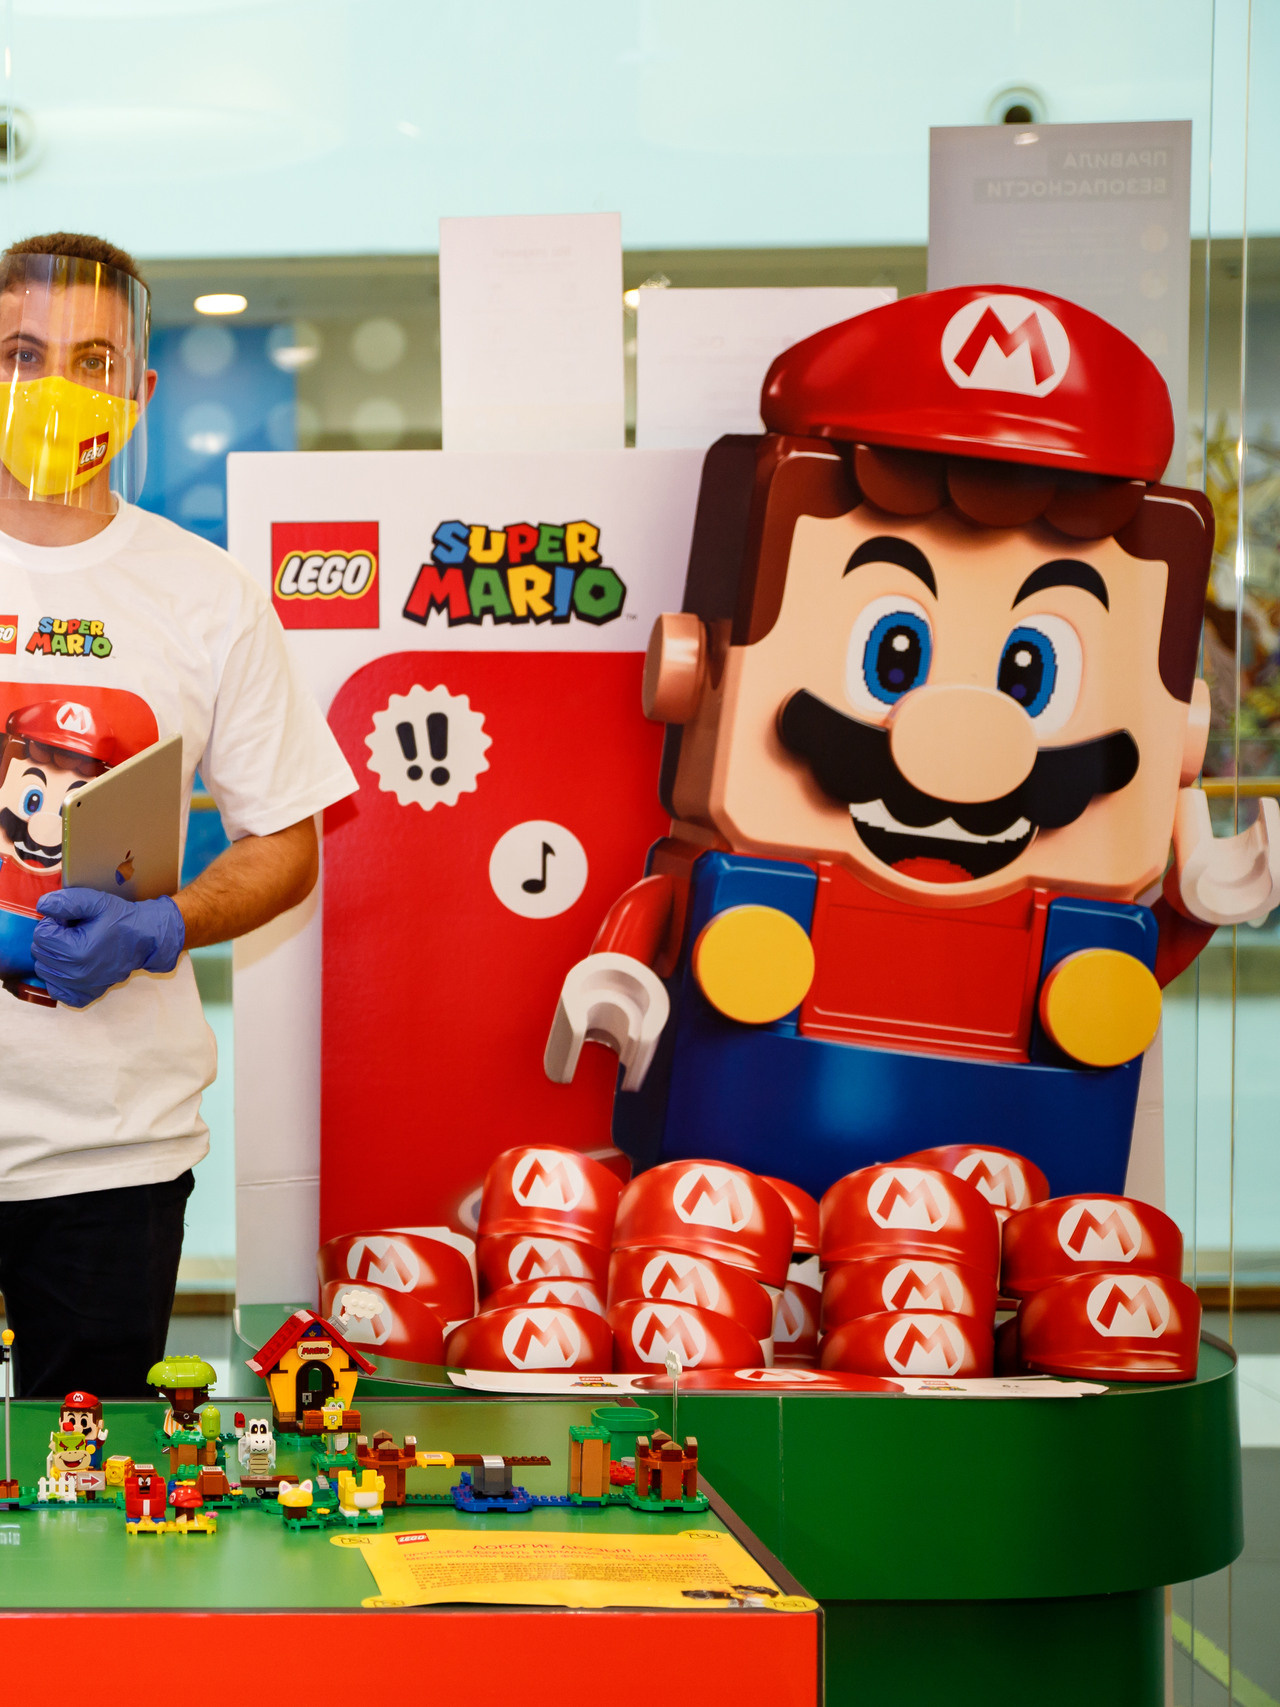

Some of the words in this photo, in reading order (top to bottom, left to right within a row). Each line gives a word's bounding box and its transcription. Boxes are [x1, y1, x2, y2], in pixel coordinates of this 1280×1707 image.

[953, 305, 1055, 386] M
[431, 520, 603, 567] SUPER
[275, 550, 377, 600] LEGO
[403, 564, 627, 627] MARIO
[25, 632, 113, 659] MARIO
[38, 616, 105, 636] SUPER
[681, 1174, 741, 1224] M
[876, 1176, 943, 1224] M
[1067, 1208, 1135, 1256] M
[1097, 1283, 1163, 1331] M
[302, 1347, 330, 1355] MARIO
[512, 1317, 576, 1363] M
[893, 1322, 959, 1369] M
